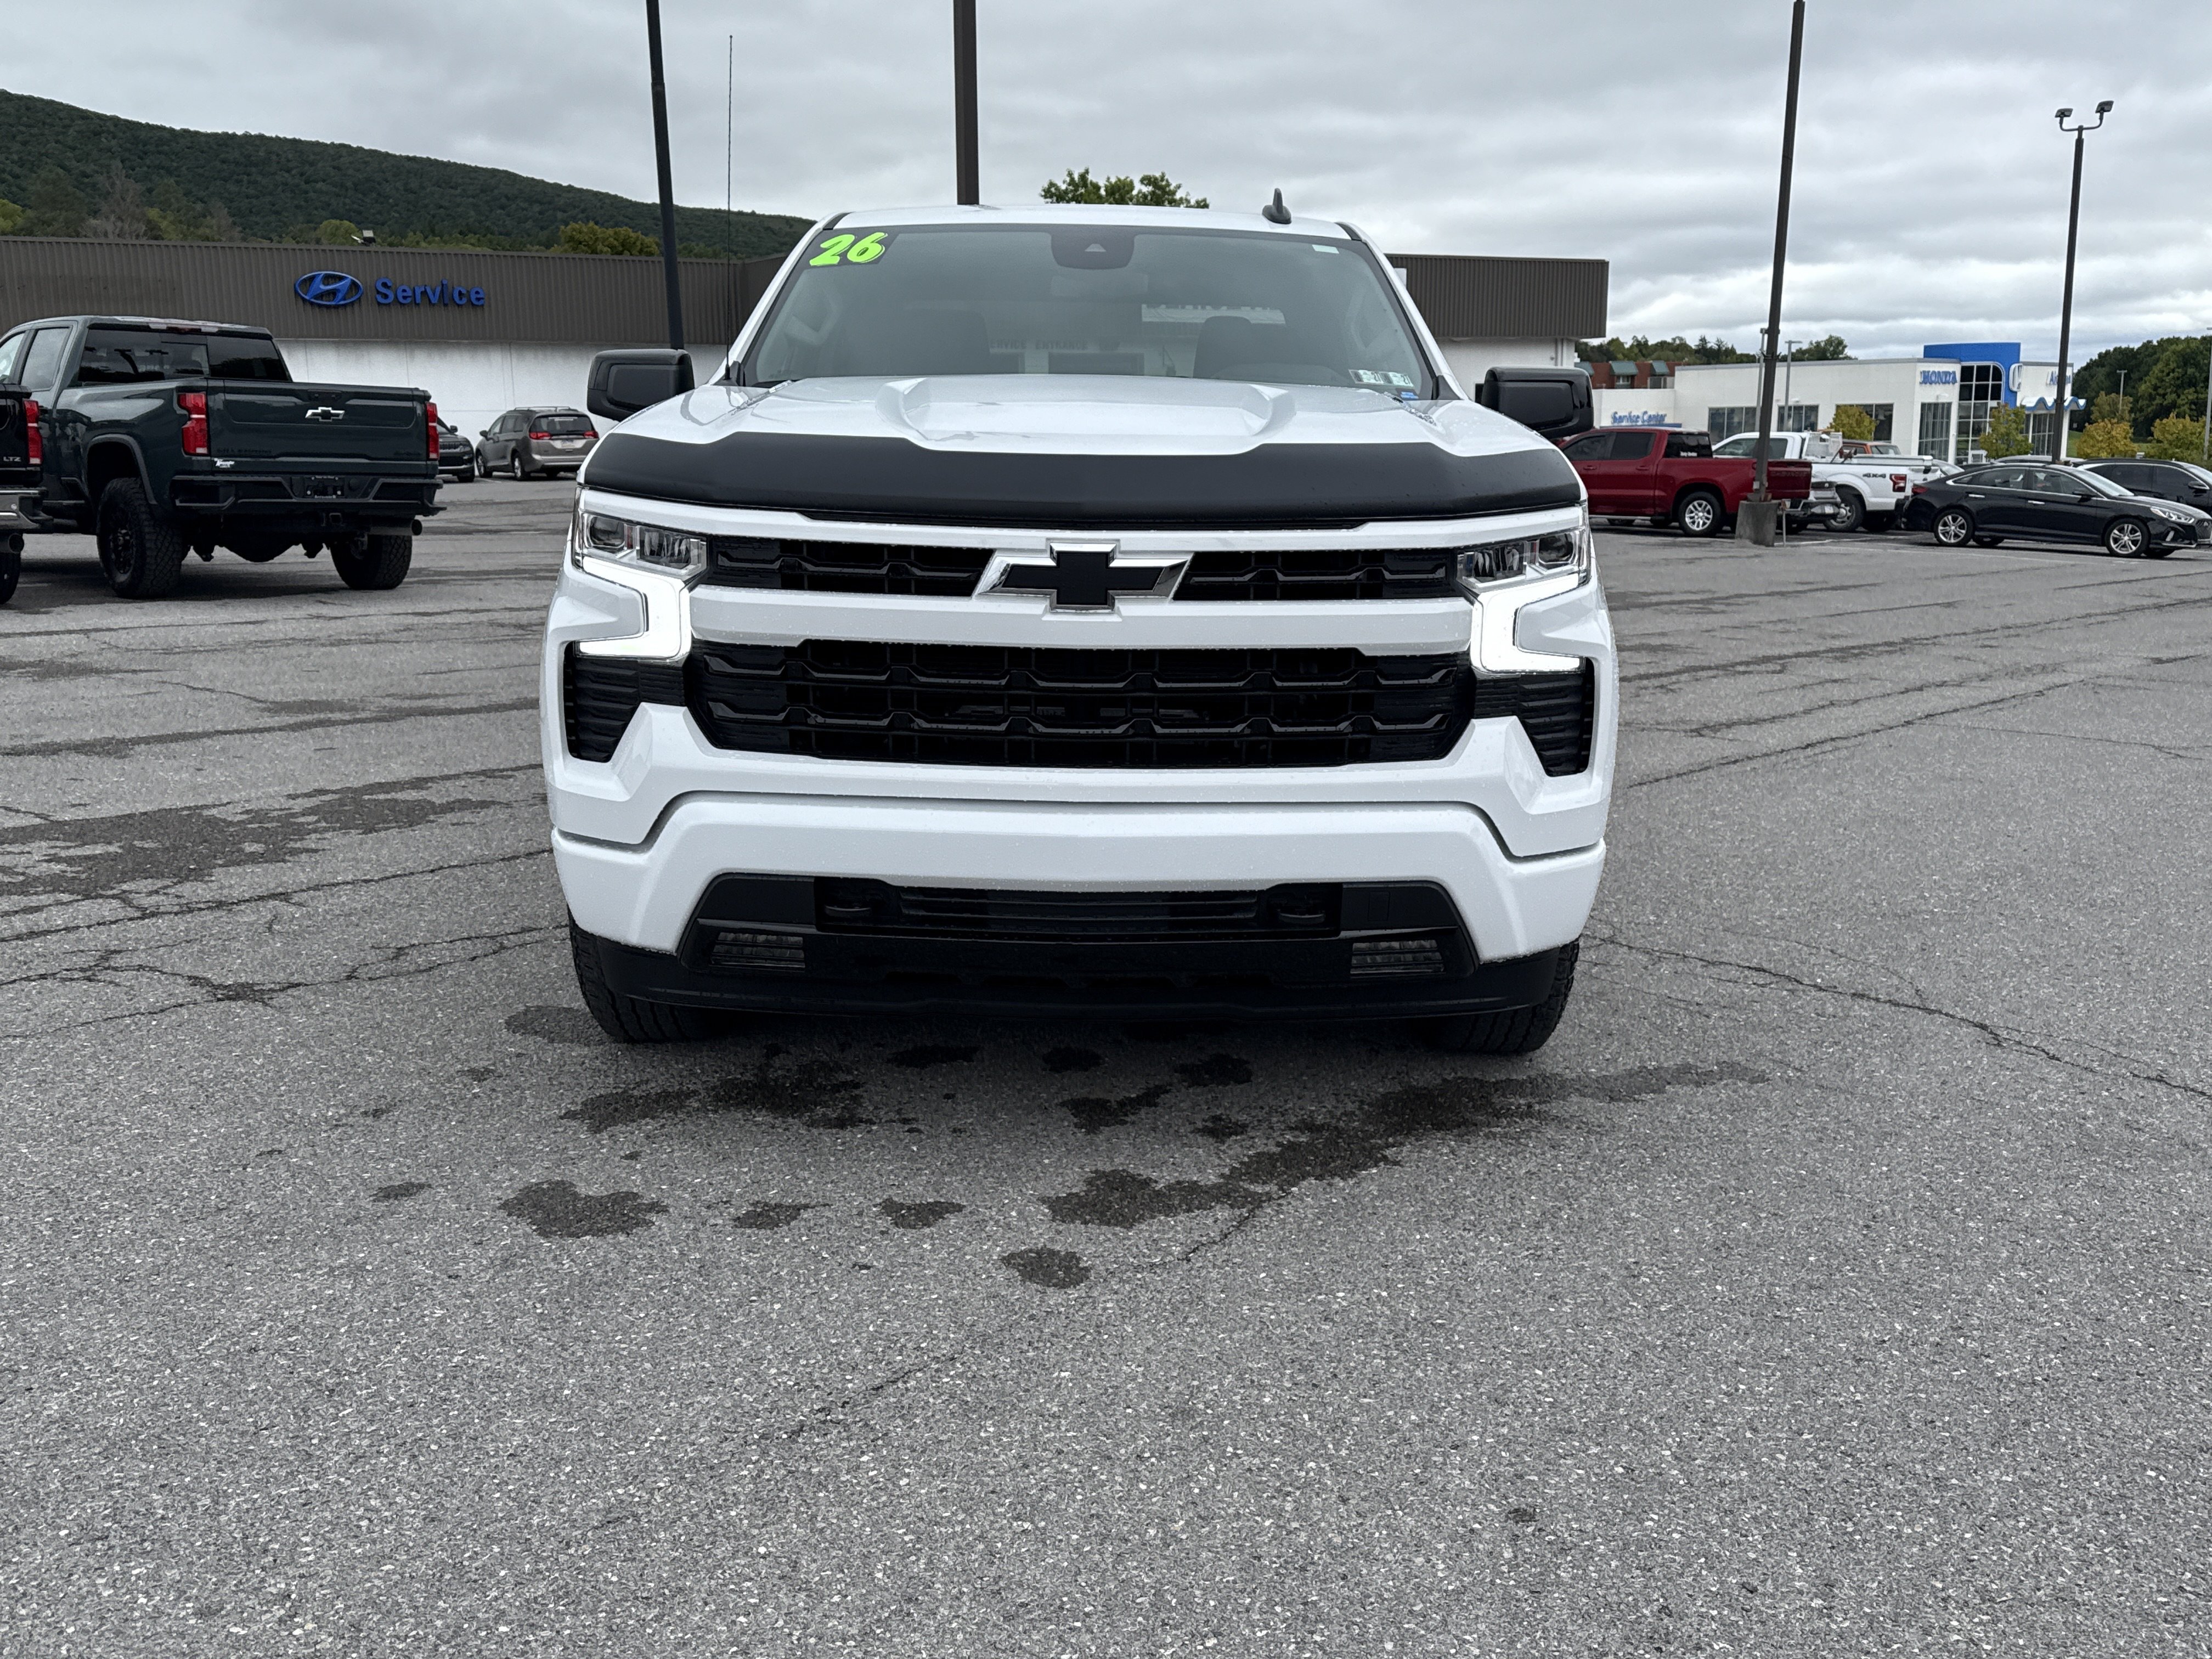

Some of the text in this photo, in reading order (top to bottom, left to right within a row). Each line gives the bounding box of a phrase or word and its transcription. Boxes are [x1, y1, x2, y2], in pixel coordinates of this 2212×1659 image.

[809, 232, 888, 267] 26
[375, 277, 486, 306] Service
[1920, 370, 1957, 385] HONDA
[1611, 410, 1667, 424] Service Center
